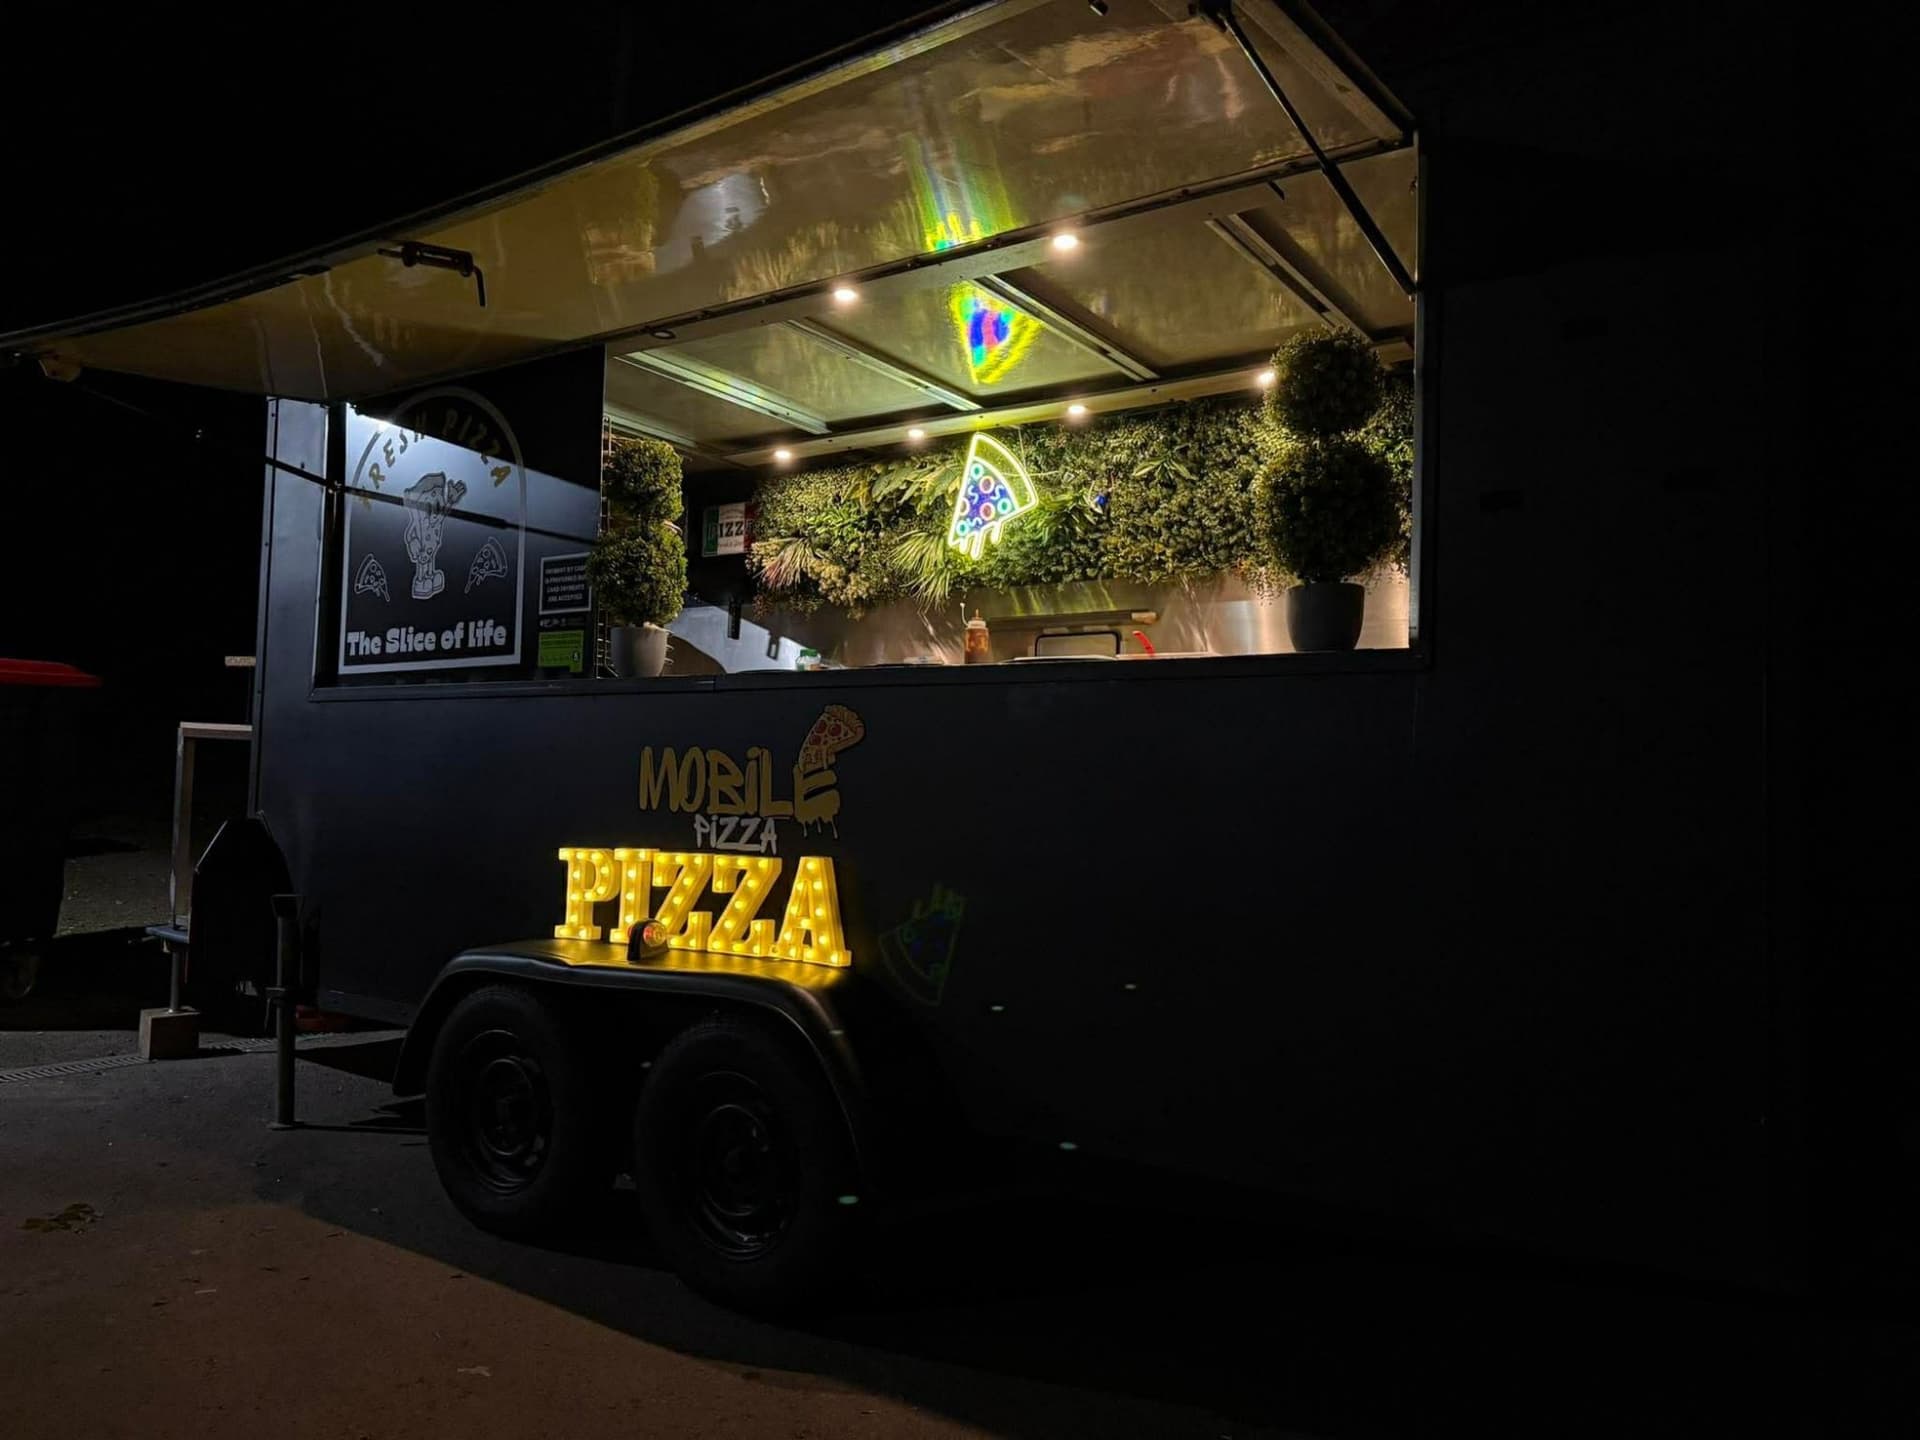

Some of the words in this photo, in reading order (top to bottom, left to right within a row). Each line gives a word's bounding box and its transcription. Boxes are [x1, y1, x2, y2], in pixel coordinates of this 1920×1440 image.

[347, 630, 382, 656] The
[385, 625, 437, 654] Slice
[440, 621, 465, 650] of
[467, 618, 507, 648] life
[554, 847, 852, 967] PIZZA
